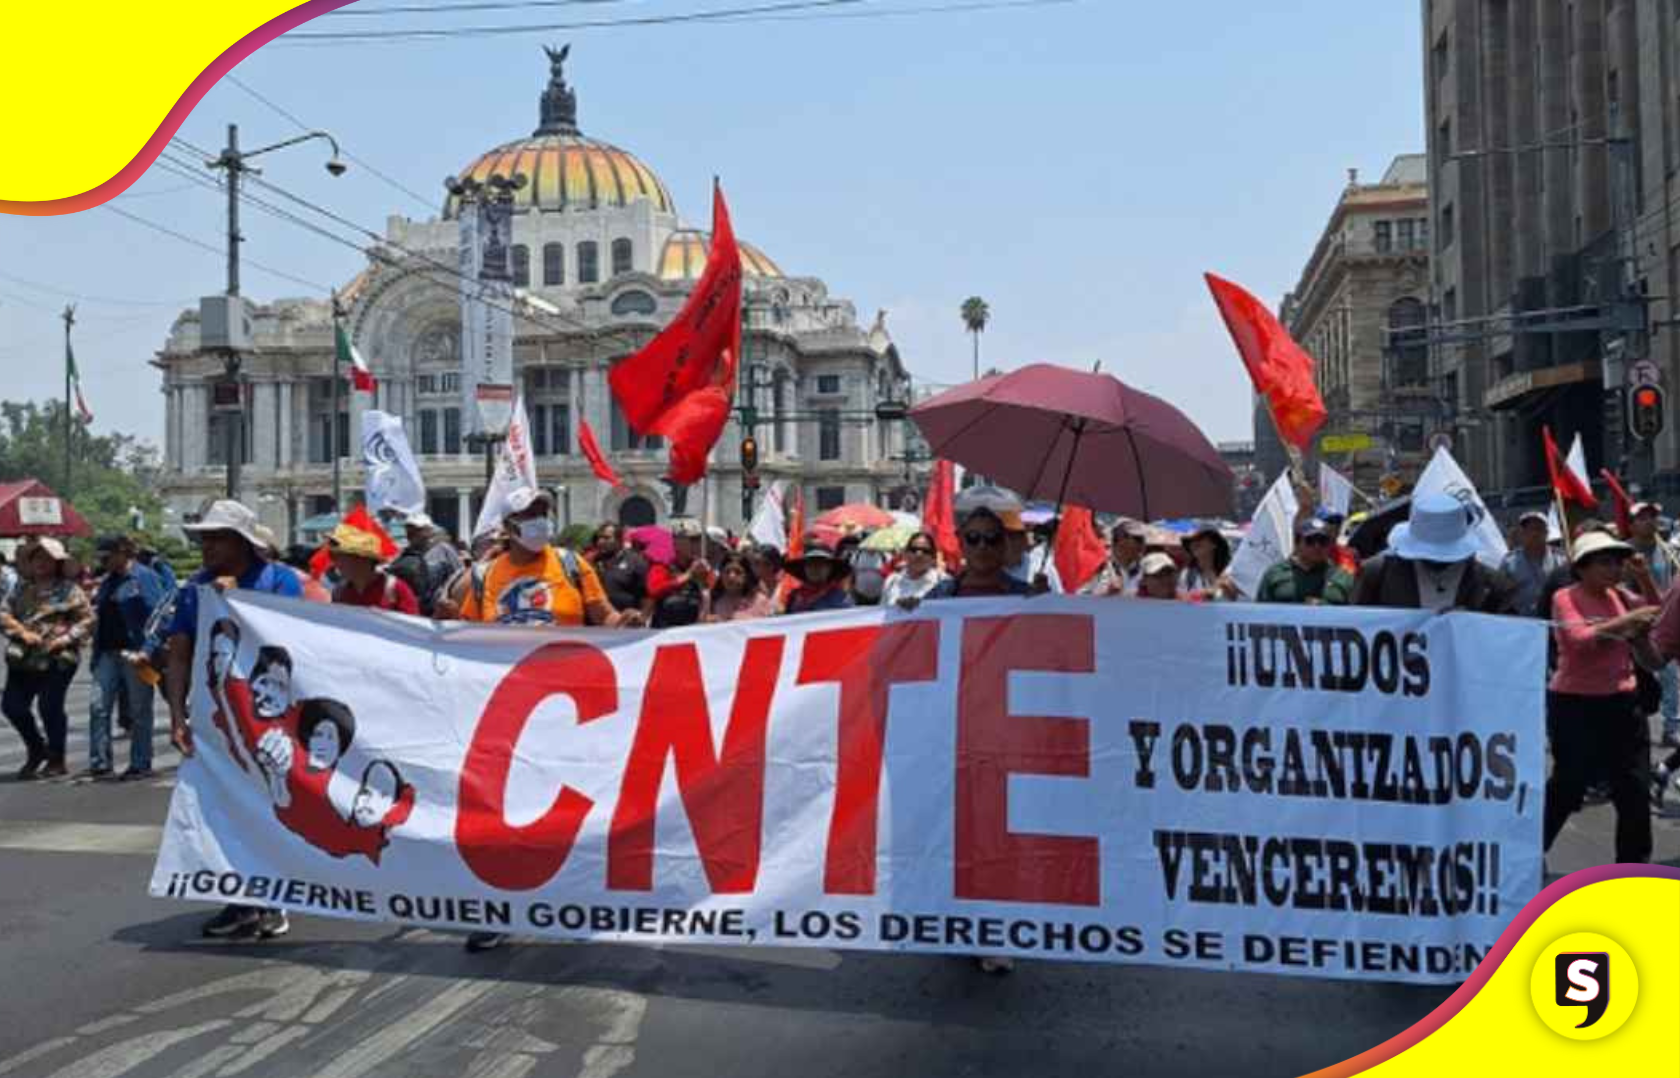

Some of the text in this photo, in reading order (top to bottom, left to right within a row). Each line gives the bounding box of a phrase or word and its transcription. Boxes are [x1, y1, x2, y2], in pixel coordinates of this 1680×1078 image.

[455, 613, 1100, 906] CNTE
[1129, 720, 1527, 813] Y ORGANIZADOS,
[167, 868, 376, 914] ¡¡GOBIERNE
[389, 893, 511, 926] QUIEN
[528, 902, 756, 942] GOBIERNE,
[775, 910, 860, 939] LOS
[880, 914, 1143, 956] DERECHOS
[1164, 931, 1223, 960] SE
[1153, 829, 1500, 916] VENCEREMOS!!
